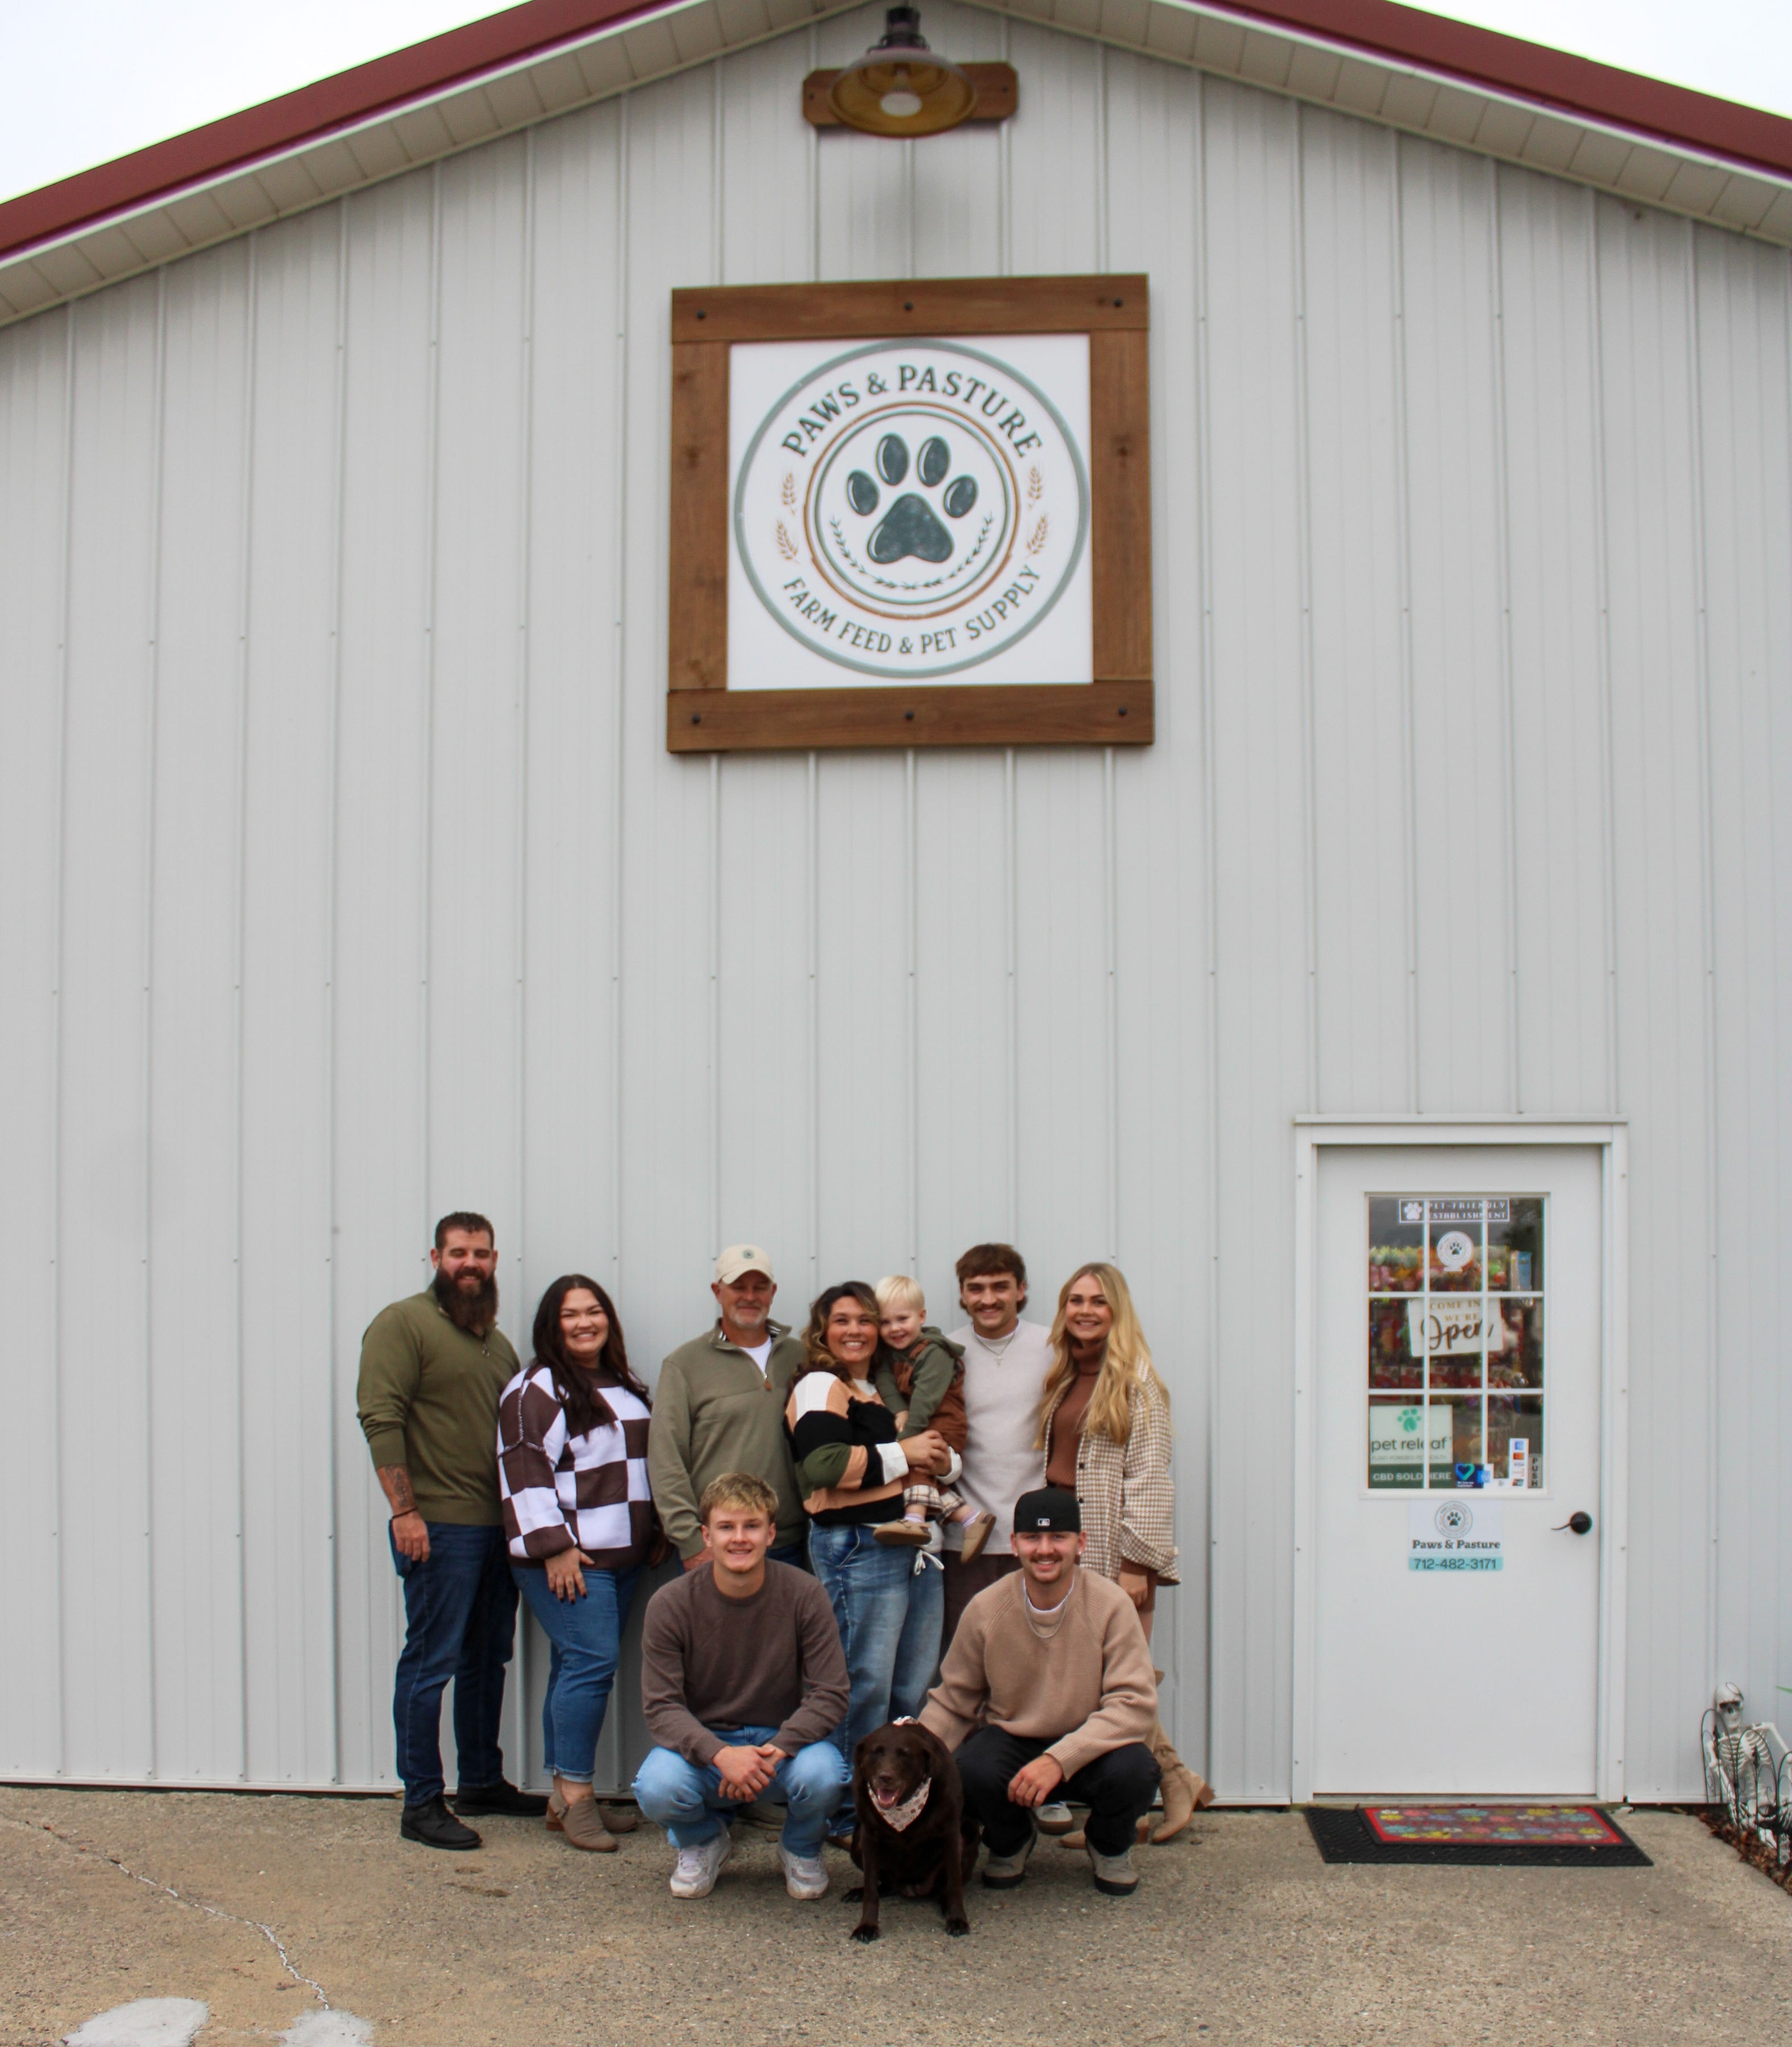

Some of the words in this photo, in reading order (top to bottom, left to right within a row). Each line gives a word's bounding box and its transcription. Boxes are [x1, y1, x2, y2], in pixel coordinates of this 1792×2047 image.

[781, 380, 861, 457] PAWS
[867, 371, 889, 395] &
[898, 363, 1043, 458] PASTURE
[783, 576, 838, 632] FARM
[837, 620, 892, 653] FEED
[899, 636, 914, 654] &
[920, 627, 956, 654] PET
[965, 565, 1040, 641] SUPPLY
[1420, 1315, 1495, 1350] Open
[1371, 1437, 1397, 1453] pet
[1373, 1472, 1394, 1481] CBD
[1396, 1472, 1424, 1481] SOLD
[1412, 1539, 1443, 1549] Paws
[1445, 1539, 1454, 1549] &
[1456, 1539, 1501, 1549] Pasture
[1414, 1558, 1497, 1570] 712-482-3171
